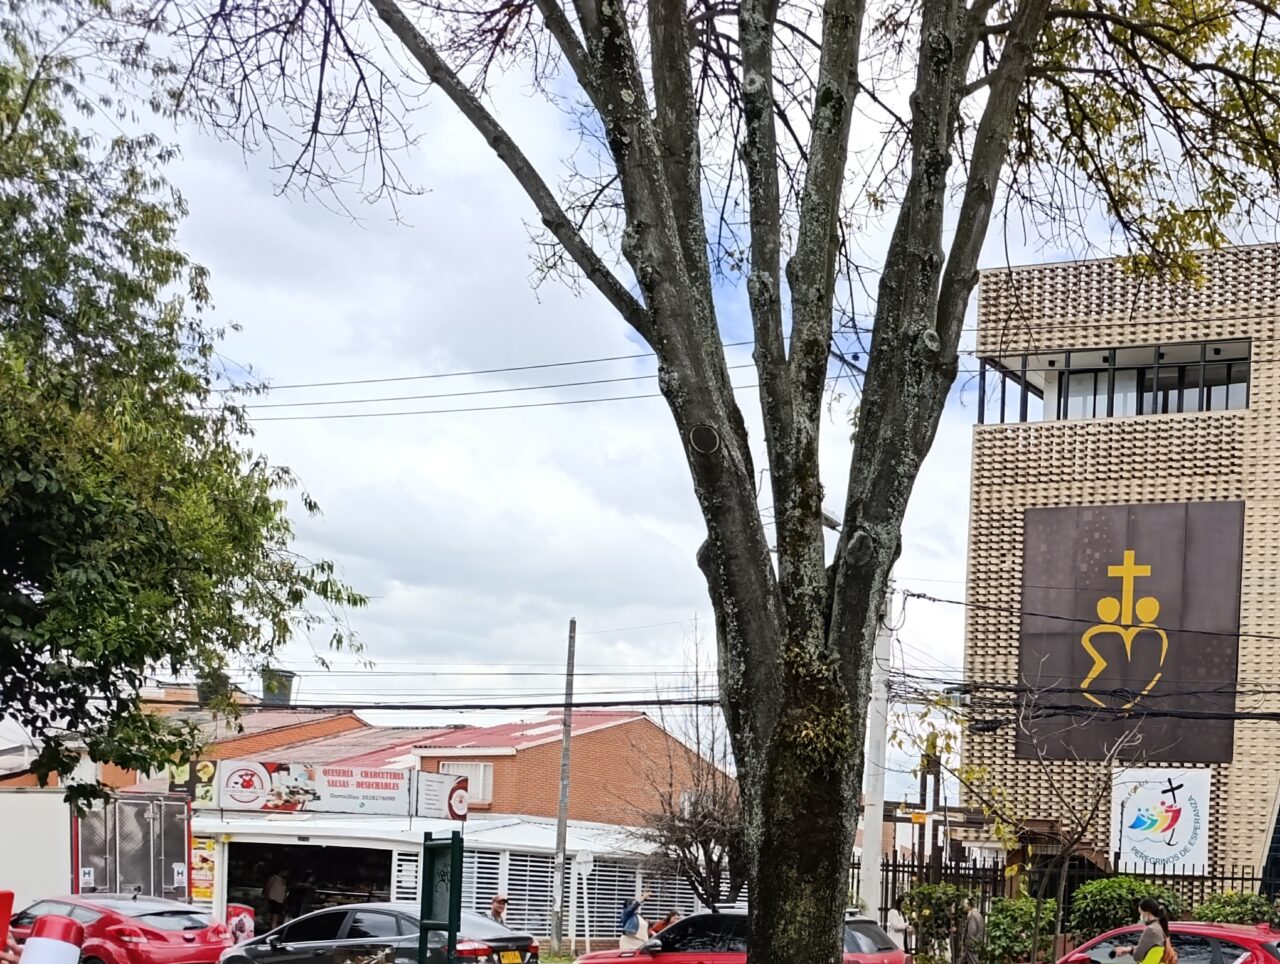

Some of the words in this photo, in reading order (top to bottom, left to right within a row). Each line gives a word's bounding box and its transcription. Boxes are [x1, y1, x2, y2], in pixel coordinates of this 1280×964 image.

[327, 780, 349, 788] SALSAS
[356, 781, 399, 790] DESECHABLES
[1131, 846, 1180, 865] PEREGRINOS
[1180, 845, 1191, 858] DE
[1188, 794, 1201, 847] ESPERANZA
[83, 870, 91, 878] H
[176, 870, 184, 878] H
